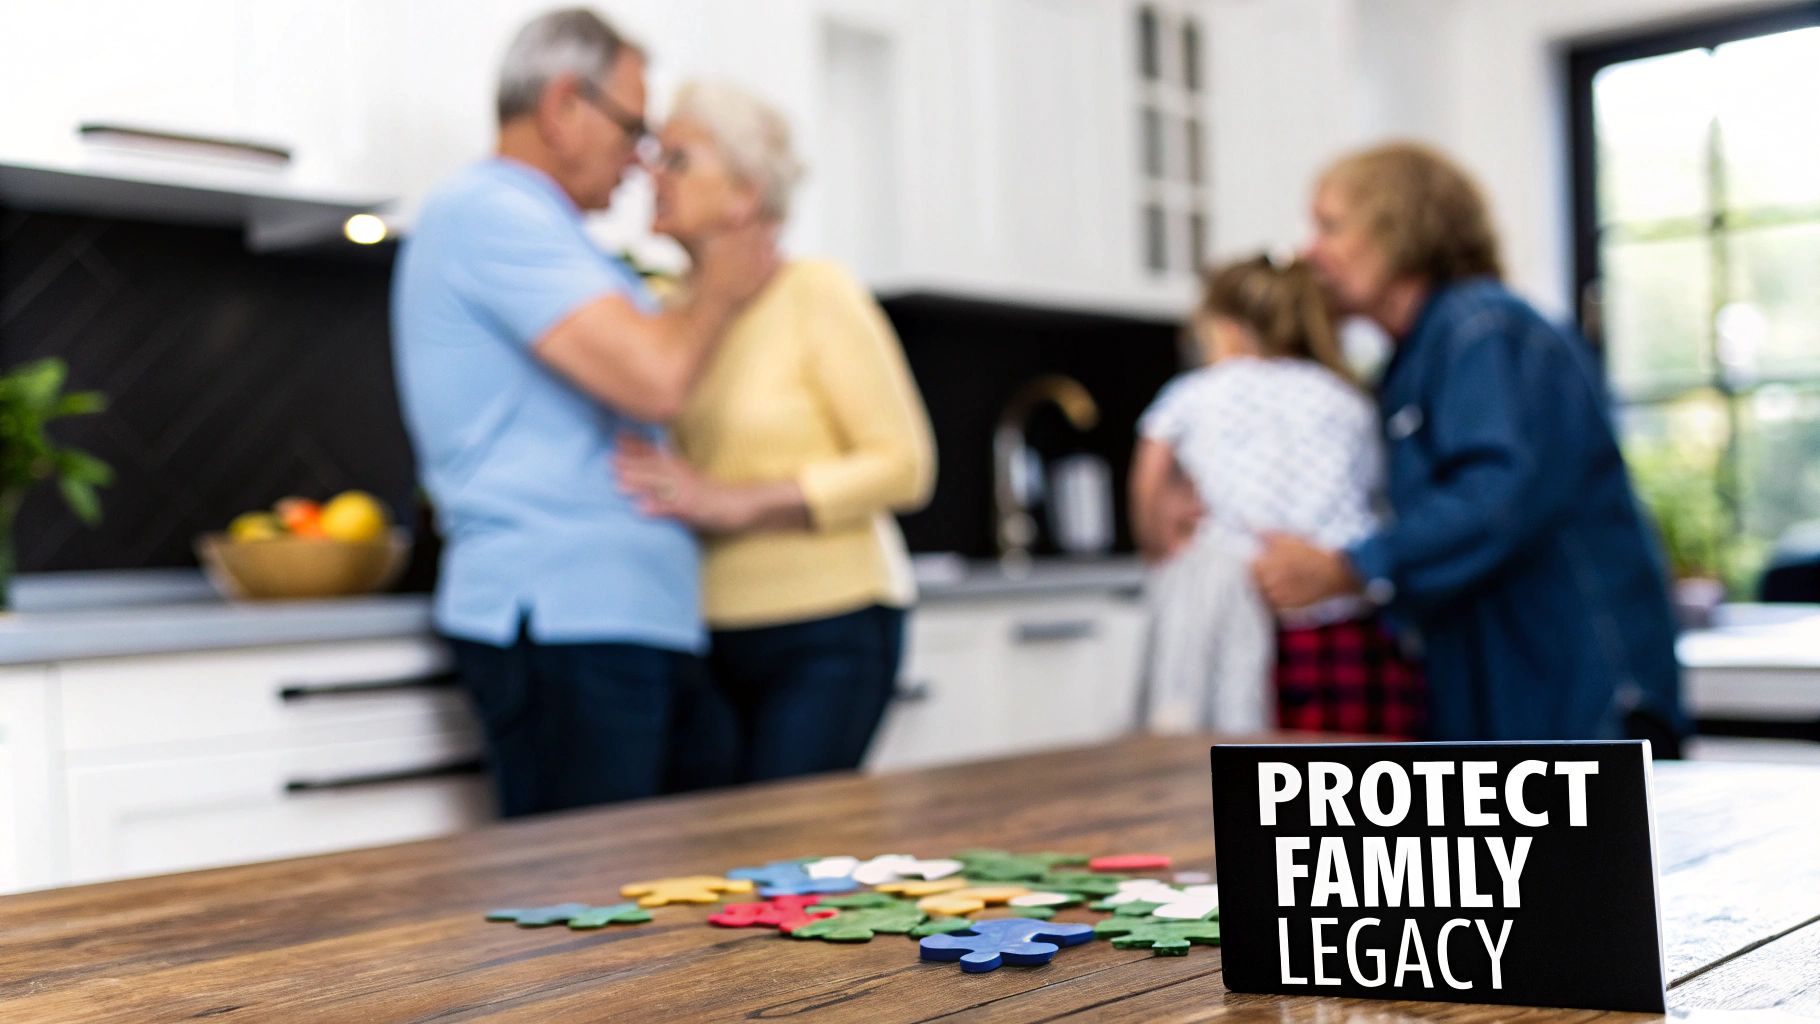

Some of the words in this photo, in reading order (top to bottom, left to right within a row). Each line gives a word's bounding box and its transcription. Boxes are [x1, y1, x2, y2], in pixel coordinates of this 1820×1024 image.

[1258, 760, 1600, 828] PROTECT
[1275, 836, 1534, 908] FAMILY
[1277, 917, 1514, 990] LEGACY
